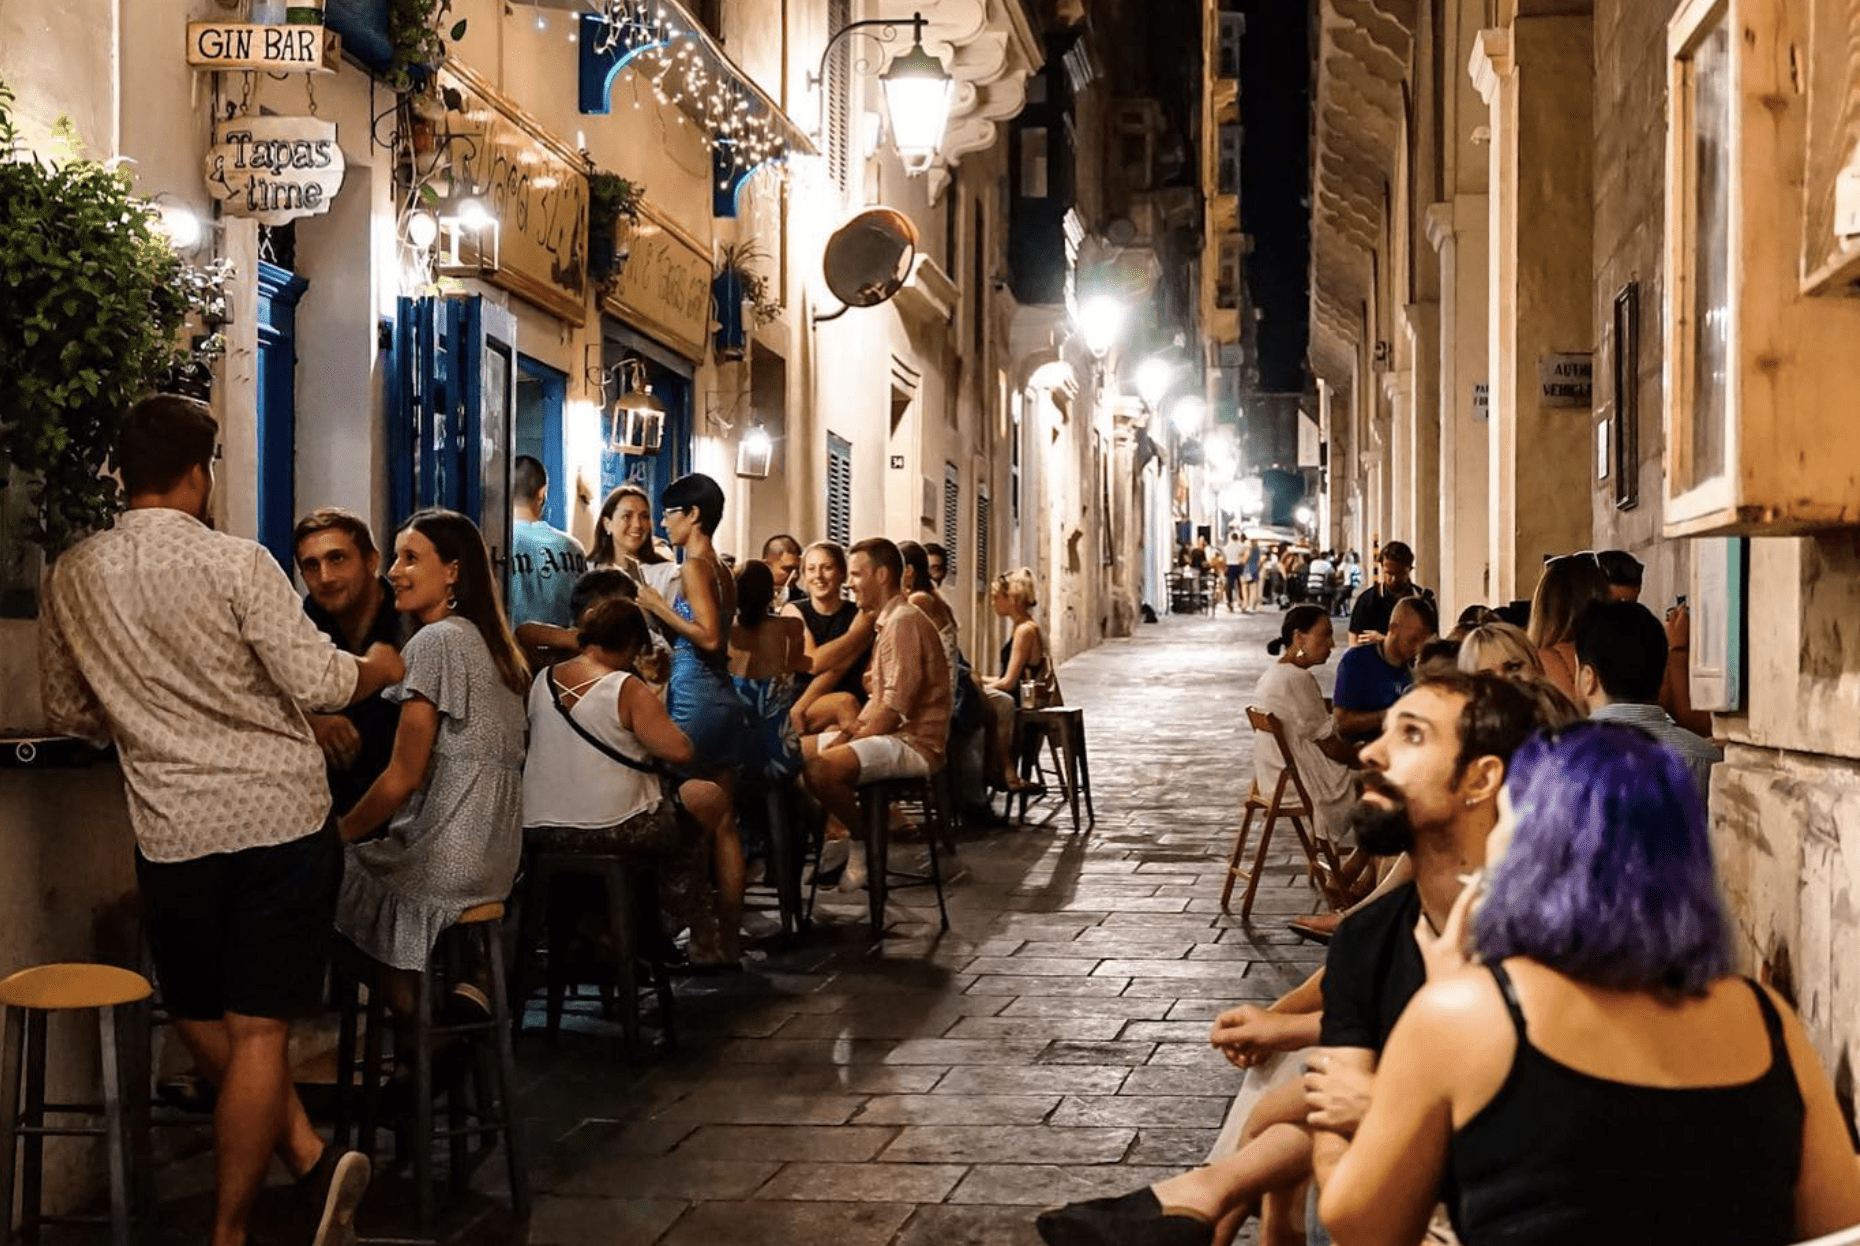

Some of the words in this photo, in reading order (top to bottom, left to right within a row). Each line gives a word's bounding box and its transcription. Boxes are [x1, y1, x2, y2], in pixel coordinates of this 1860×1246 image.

[198, 29, 253, 59] GIN
[263, 28, 315, 61] BAR
[226, 130, 332, 176] Tapas
[245, 174, 323, 212] time
